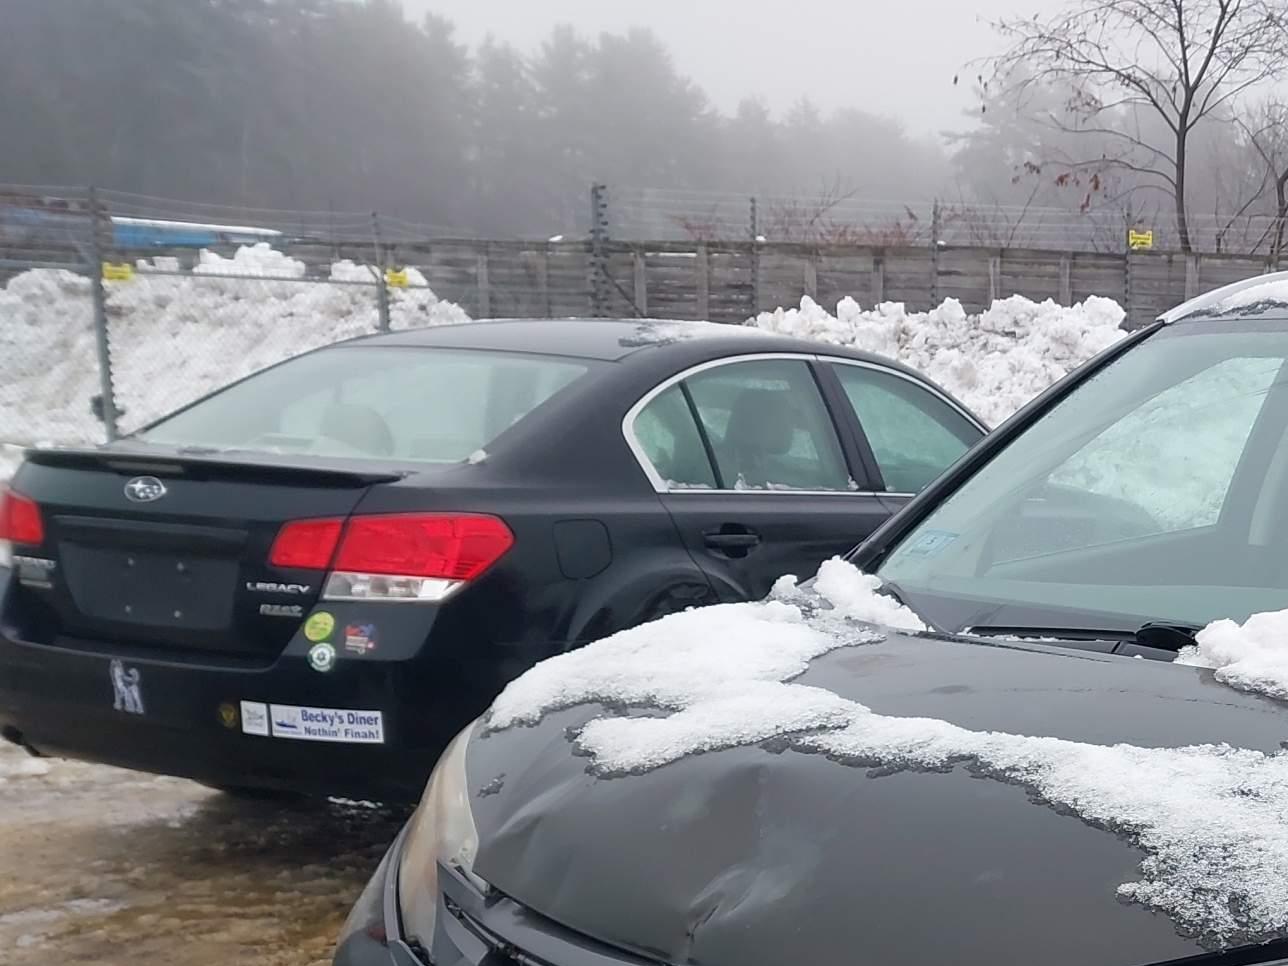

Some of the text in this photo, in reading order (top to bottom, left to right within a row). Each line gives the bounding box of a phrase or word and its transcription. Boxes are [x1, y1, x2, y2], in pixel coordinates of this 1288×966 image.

[246, 582, 310, 594] LEGACY
[301, 709, 379, 727] Becky's Diner
[304, 726, 340, 737] Nothin'
[344, 728, 379, 739] Finah!
